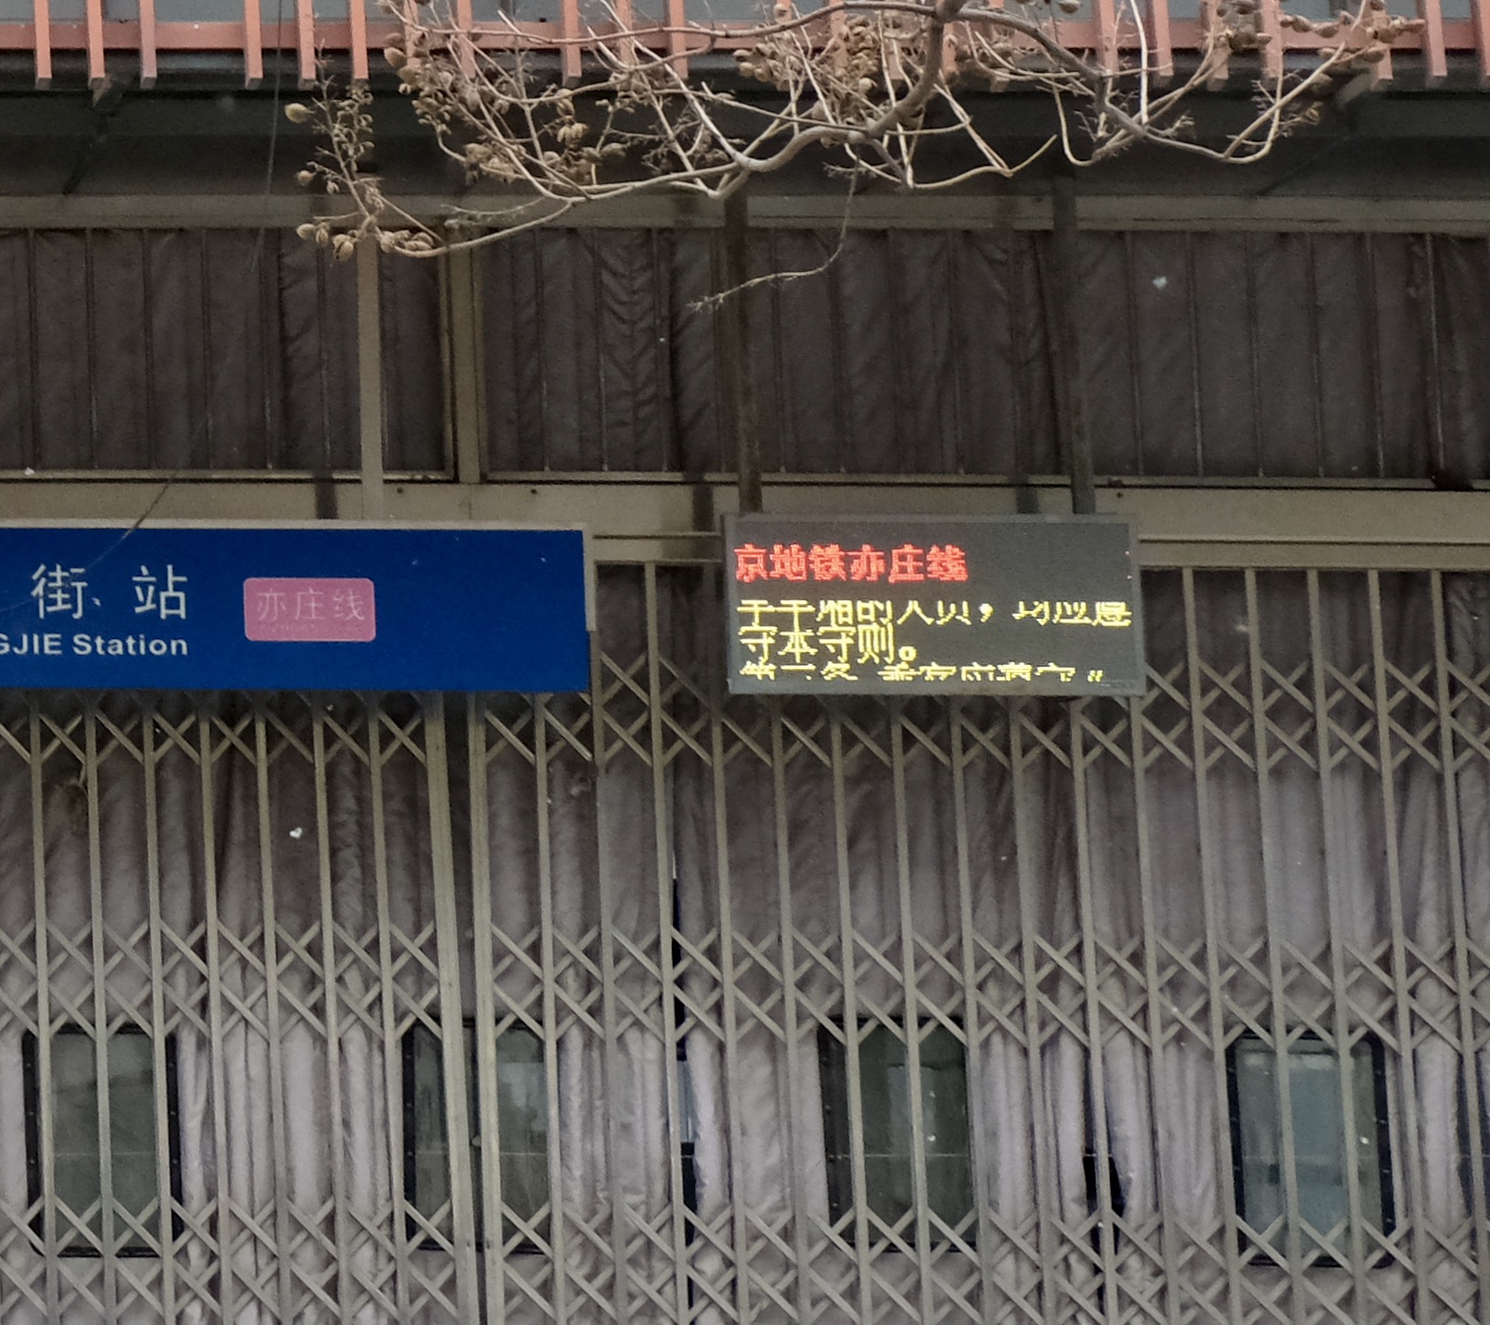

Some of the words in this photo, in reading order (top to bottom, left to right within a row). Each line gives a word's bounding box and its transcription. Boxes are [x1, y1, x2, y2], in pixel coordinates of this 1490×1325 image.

[734, 542, 969, 584] 京地铁亦庄线
[256, 586, 365, 621] 亦庄线
[72, 632, 188, 656] Station
